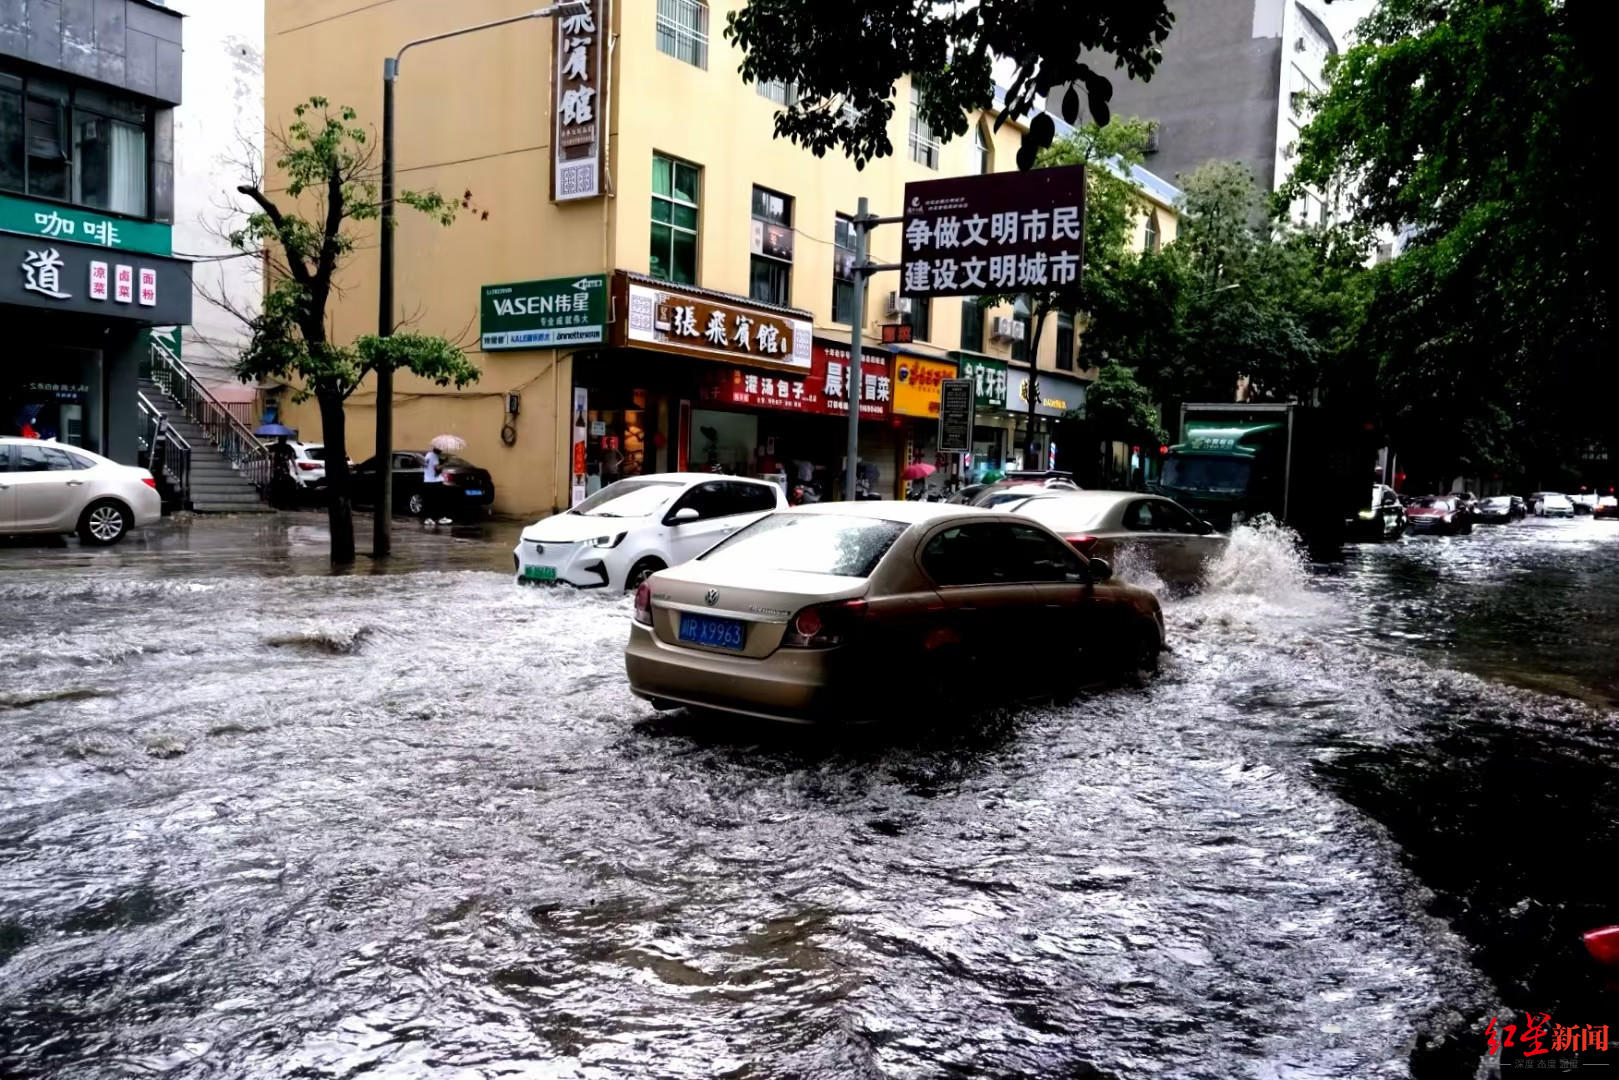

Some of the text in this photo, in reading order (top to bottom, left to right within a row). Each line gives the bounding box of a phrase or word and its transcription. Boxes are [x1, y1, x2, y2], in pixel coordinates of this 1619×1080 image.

[34, 211, 121, 247] 咖啡
[906, 206, 1080, 251] 争做文明市民
[21, 248, 73, 299] 道
[904, 250, 1080, 292] 建设文明城市
[745, 375, 804, 400] 灌汤包子
